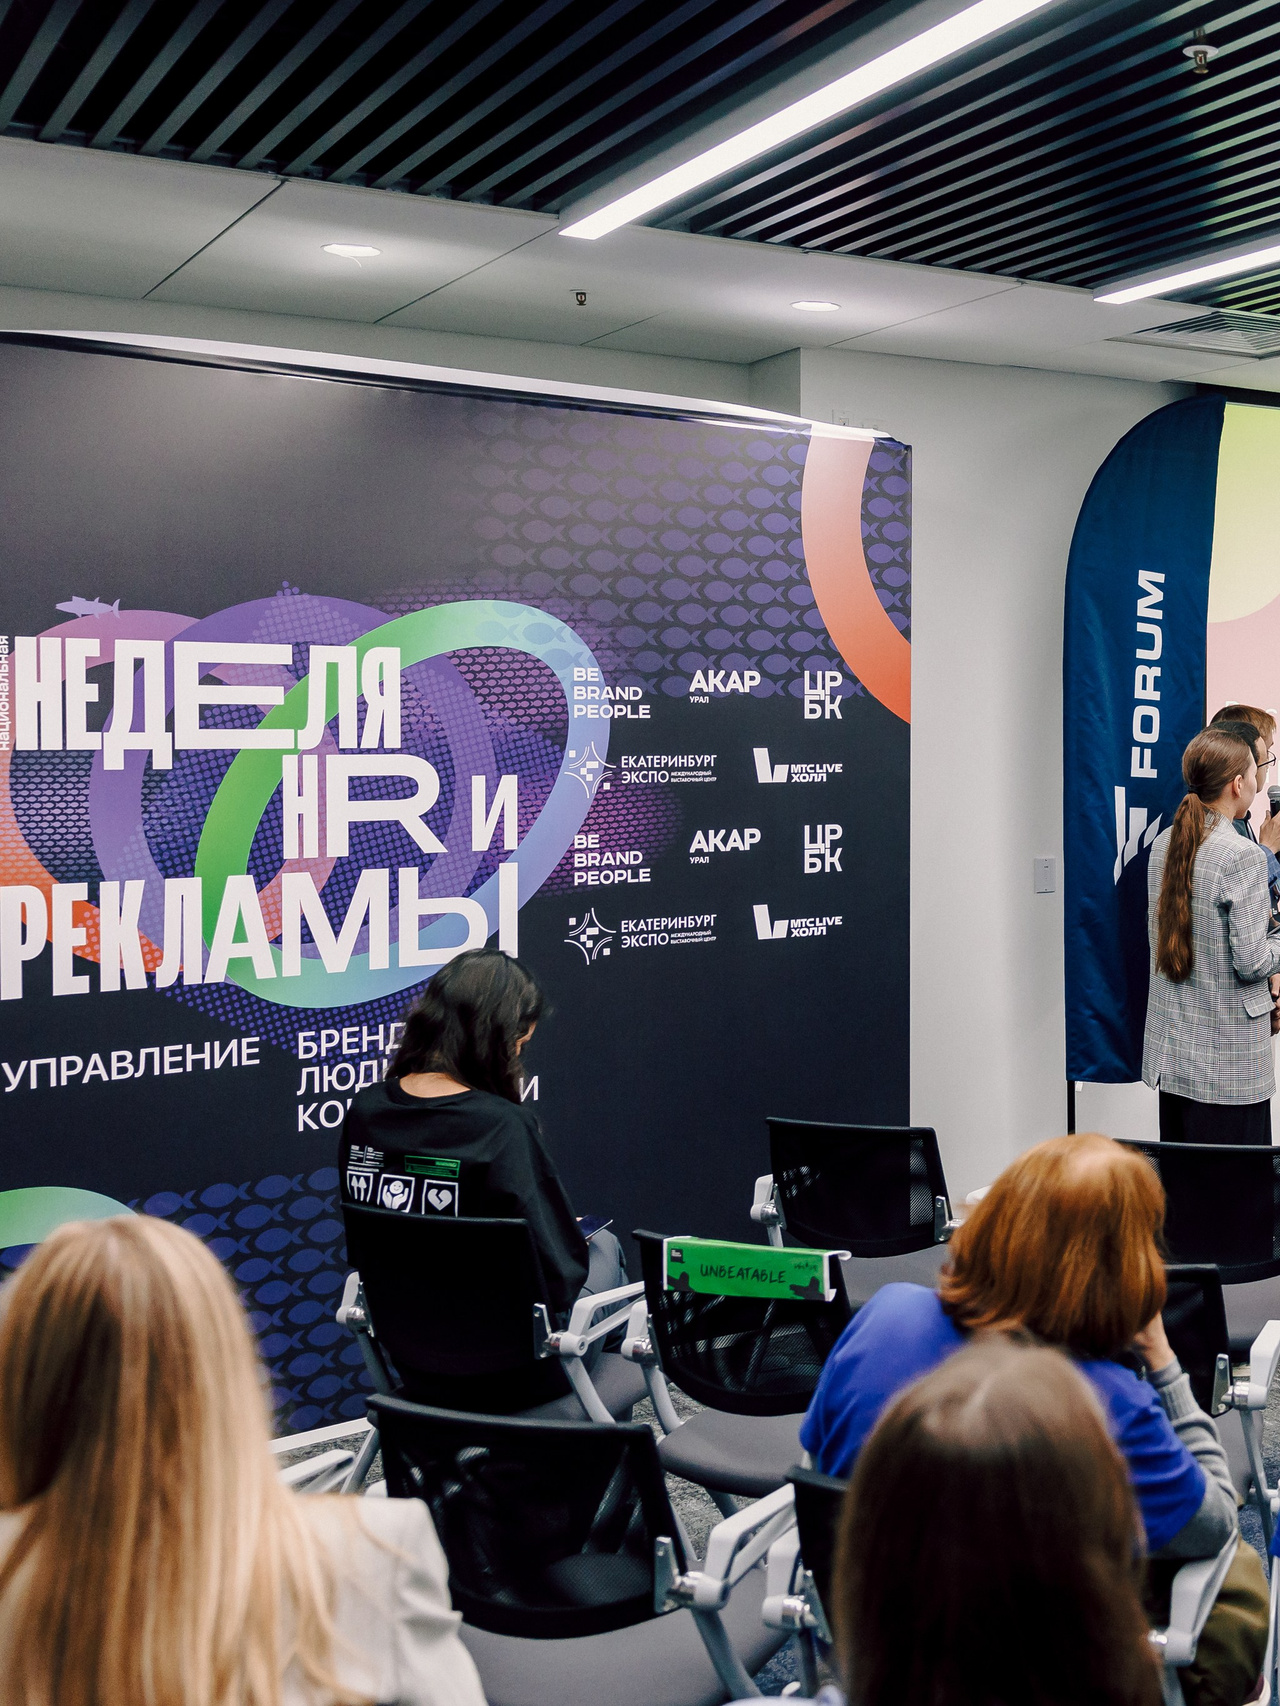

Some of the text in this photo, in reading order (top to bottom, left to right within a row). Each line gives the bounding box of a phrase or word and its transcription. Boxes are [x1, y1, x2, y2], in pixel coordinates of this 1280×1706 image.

[573, 667, 600, 682] BE
[689, 669, 761, 693] АКАР
[1130, 569, 1166, 779] FORUM
[573, 686, 643, 700] BRAND
[803, 670, 843, 700] ЦР
[15, 636, 403, 770] НЕДЕЛЯ
[573, 704, 651, 719] PEOPLE
[803, 694, 843, 719] БК
[621, 755, 717, 768] ЕКАТЕРИНБУРГ
[815, 763, 843, 773] LIVE
[621, 770, 669, 784] ЭКСПО
[790, 773, 827, 783] ХОЛЛ
[282, 754, 449, 859] HR
[574, 834, 600, 849] BE
[689, 828, 761, 853] АКАР
[803, 824, 843, 854] ЦР
[574, 851, 643, 868] BRAND
[689, 856, 710, 864] УРАЛ
[803, 848, 843, 874] БК
[574, 868, 651, 886] PEOPLE
[621, 914, 717, 933] ЕКАТЕРИНБУРГ
[815, 916, 843, 926] LIVE
[0, 862, 519, 1000] РЕКЛАМЫ
[790, 926, 827, 938] ХОЛЛ
[621, 933, 669, 948] ЭКСПО
[298, 1022, 407, 1059] БРЕНД
[1, 1037, 260, 1093] УПРАВЛЕНИЕ
[699, 1264, 787, 1284] UNBEATABLE
